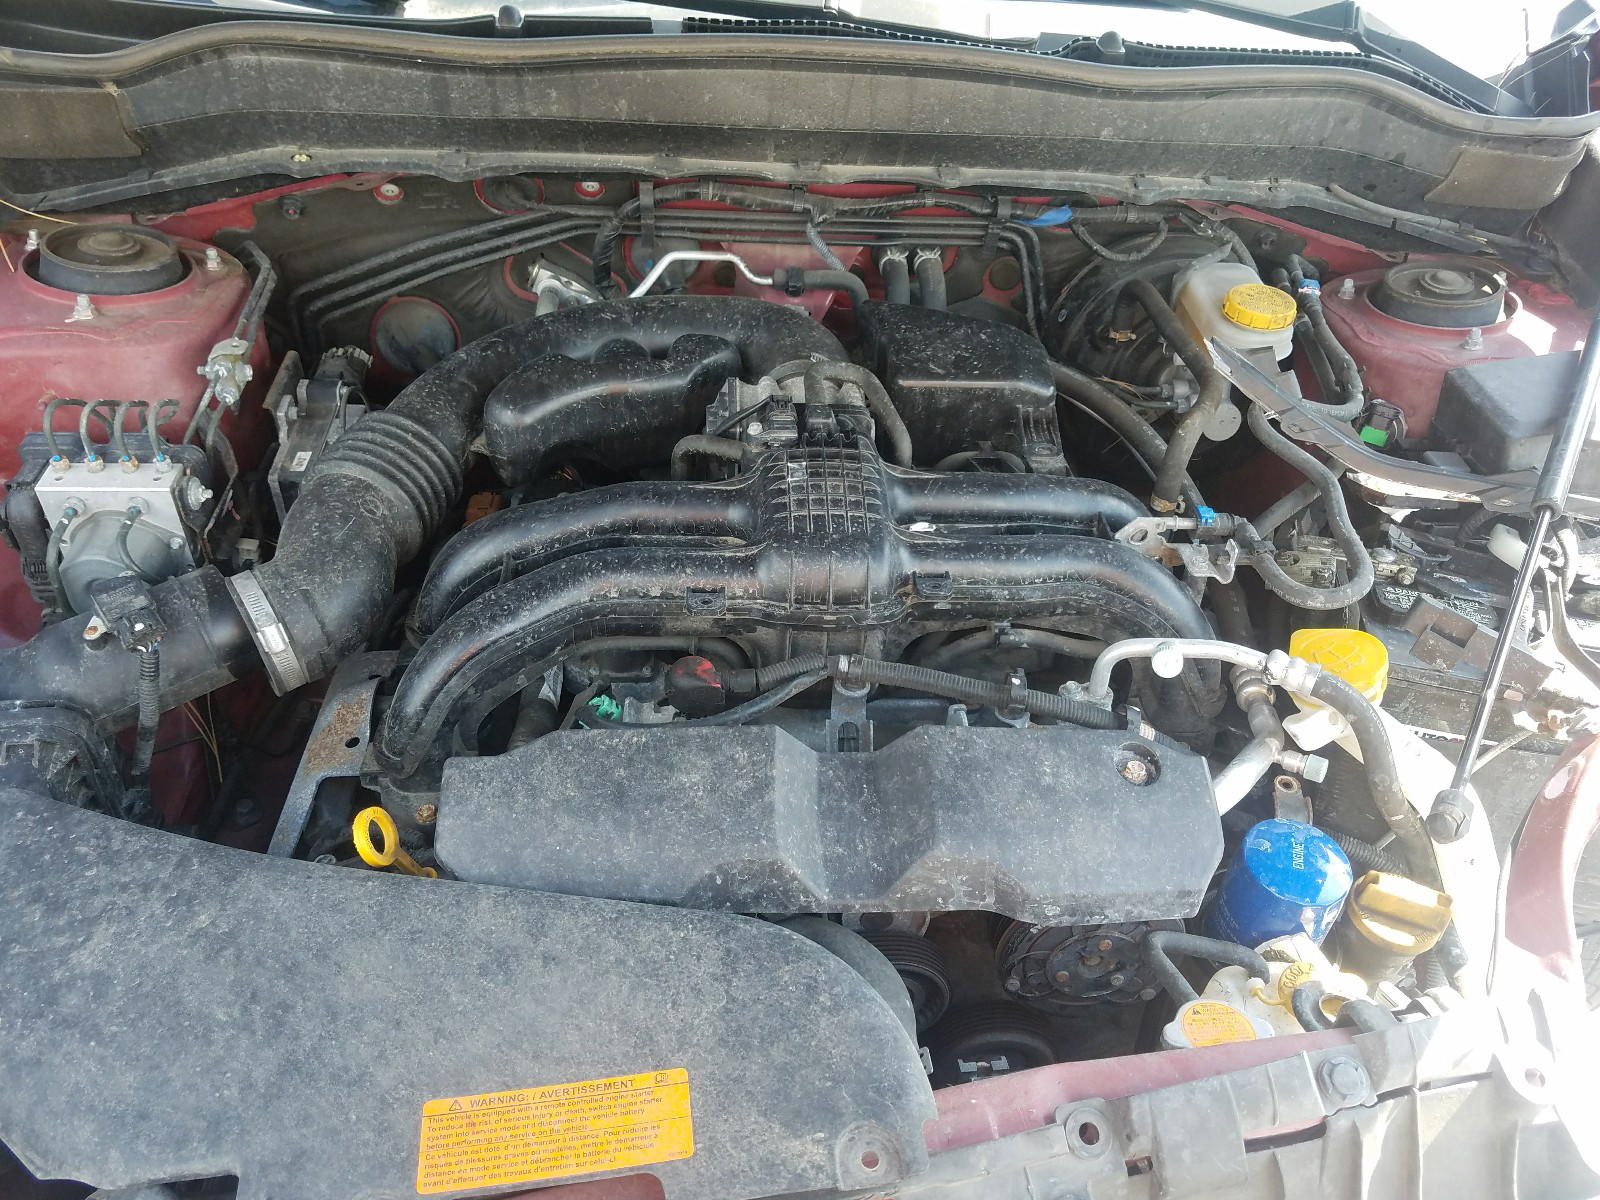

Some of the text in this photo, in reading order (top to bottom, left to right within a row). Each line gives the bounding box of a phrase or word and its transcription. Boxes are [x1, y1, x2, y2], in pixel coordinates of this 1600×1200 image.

[1292, 841, 1305, 870] ENGINE
[470, 1092, 528, 1108] WARNING:
[540, 1079, 634, 1099] AVERTISSEMENT
[438, 1122, 463, 1131] reduce
[503, 1113, 530, 1122] serious
[588, 1103, 611, 1112] switch
[446, 1112, 471, 1122] vehicle
[481, 1107, 515, 1119] equipped
[540, 1100, 565, 1110] remote
[567, 1096, 603, 1106] controlled
[426, 1132, 453, 1142] system
[471, 1126, 496, 1135] service
[500, 1123, 519, 1132] mode
[592, 1111, 617, 1120] vehicle
[426, 1141, 449, 1150] before
[452, 1135, 492, 1147] performing
[509, 1130, 535, 1139] service
[604, 1128, 620, 1137] Pour
